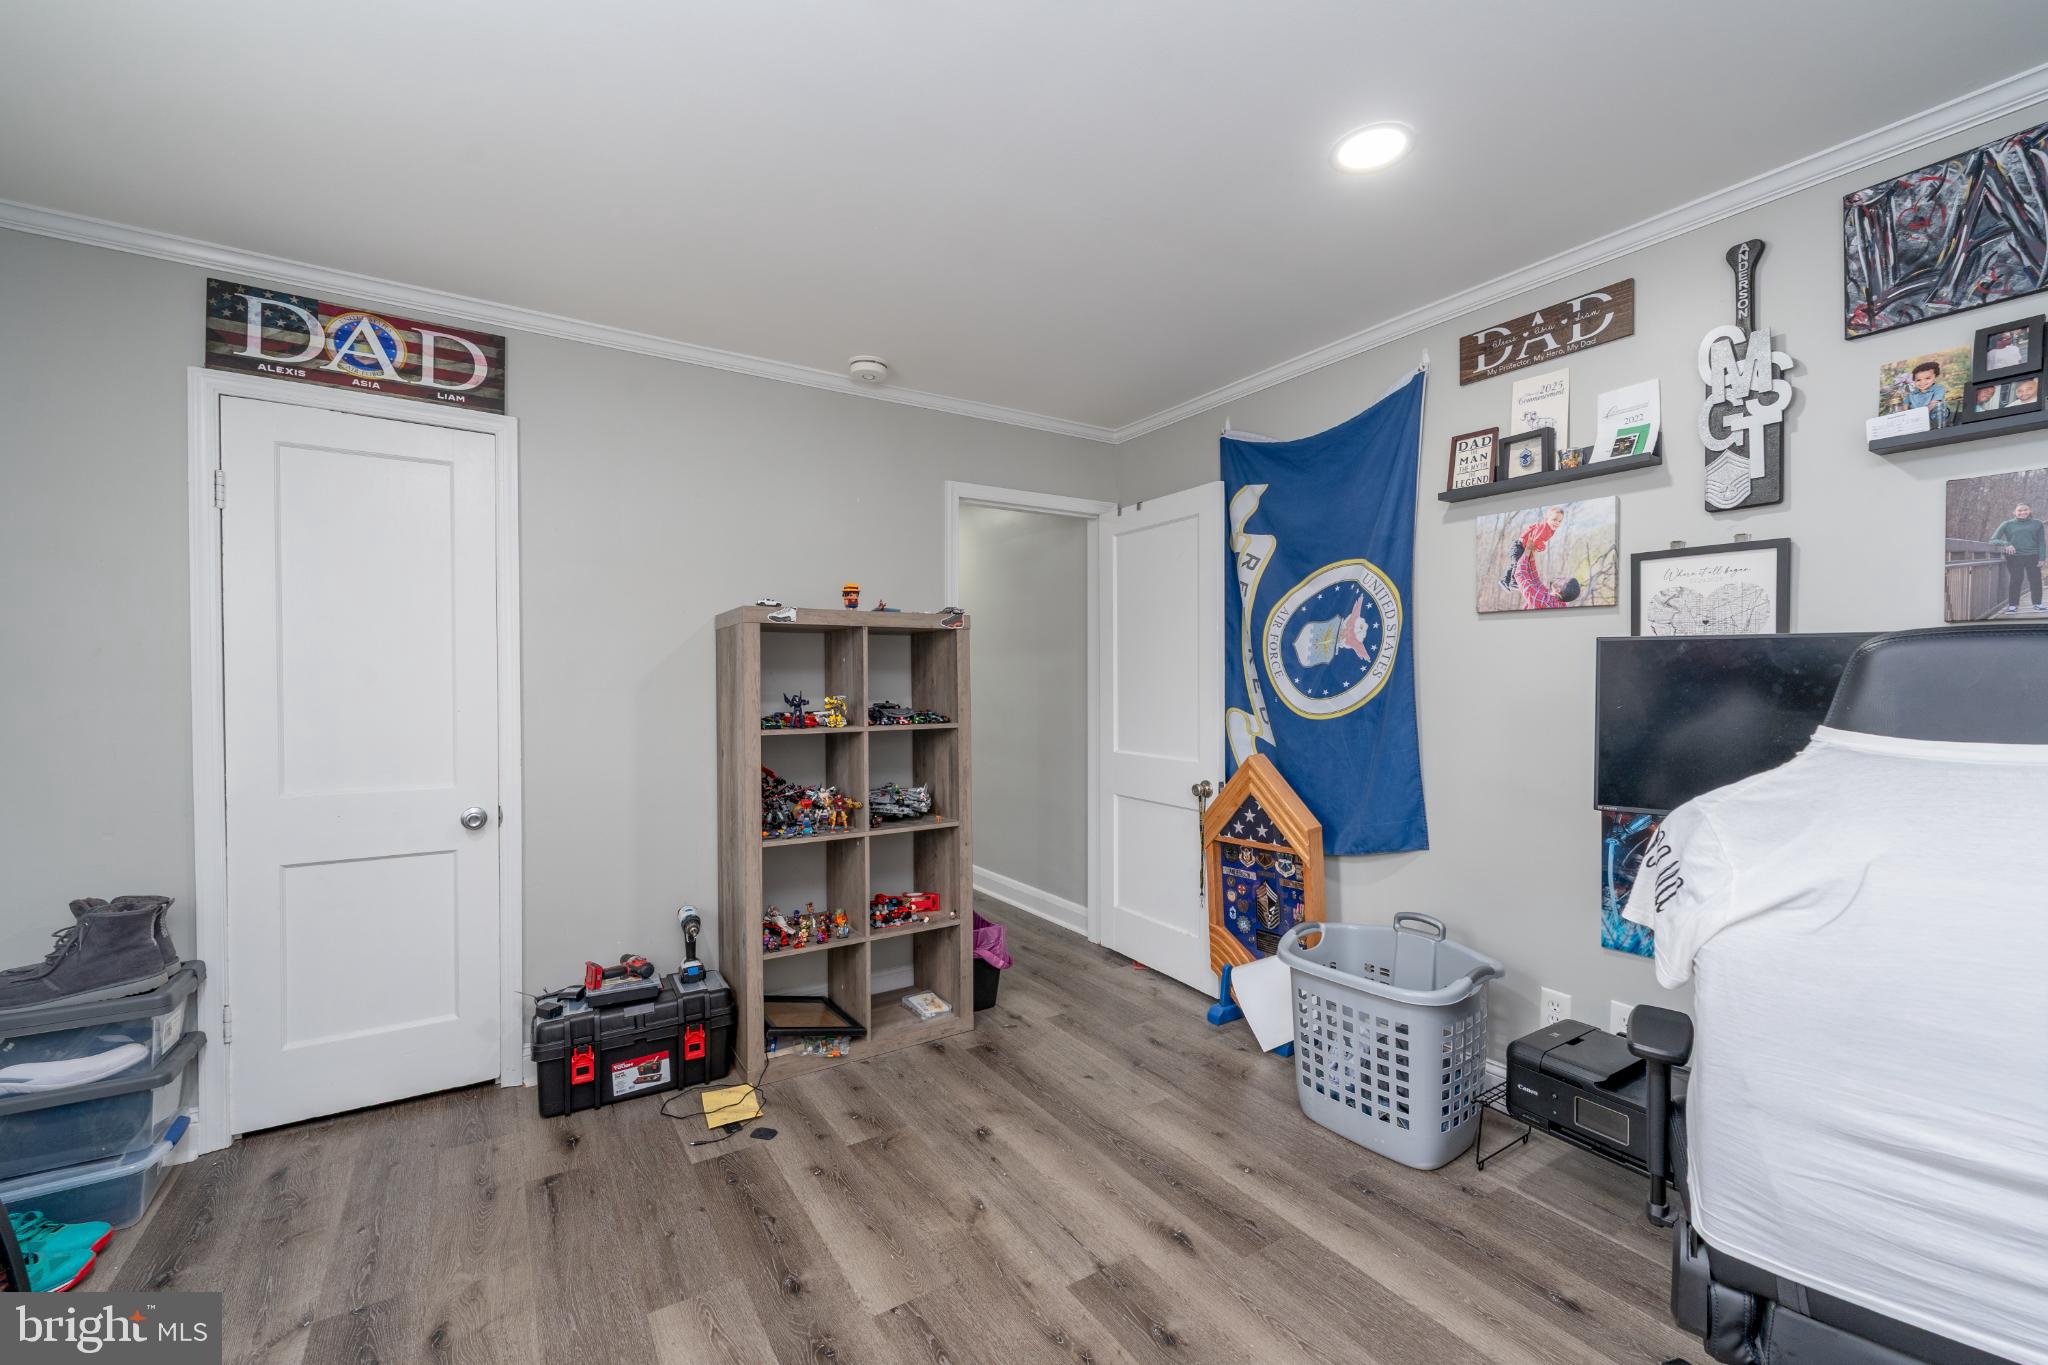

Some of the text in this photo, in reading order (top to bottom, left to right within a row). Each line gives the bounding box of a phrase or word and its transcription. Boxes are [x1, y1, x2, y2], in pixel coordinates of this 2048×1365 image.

[1737, 243, 1750, 319] ANDERSON
[1473, 292, 1615, 374] DAD
[233, 292, 488, 391] DAD
[1487, 368, 1498, 377] My
[1533, 353, 1545, 363] My
[1567, 343, 1579, 353] My
[257, 362, 306, 378] ALEXIS
[351, 378, 381, 390] ASIA
[1539, 379, 1565, 395] 2025
[437, 392, 466, 403] LIAM
[1458, 436, 1492, 452] DAD
[1460, 452, 1488, 466] MAN
[1471, 461, 1488, 471] MYTH
[1455, 475, 1489, 489] LEGEND
[1362, 572, 1397, 679] UNITED STATES
[1270, 606, 1290, 679] AIR FORCE
[1518, 1083, 1538, 1096] Canon
